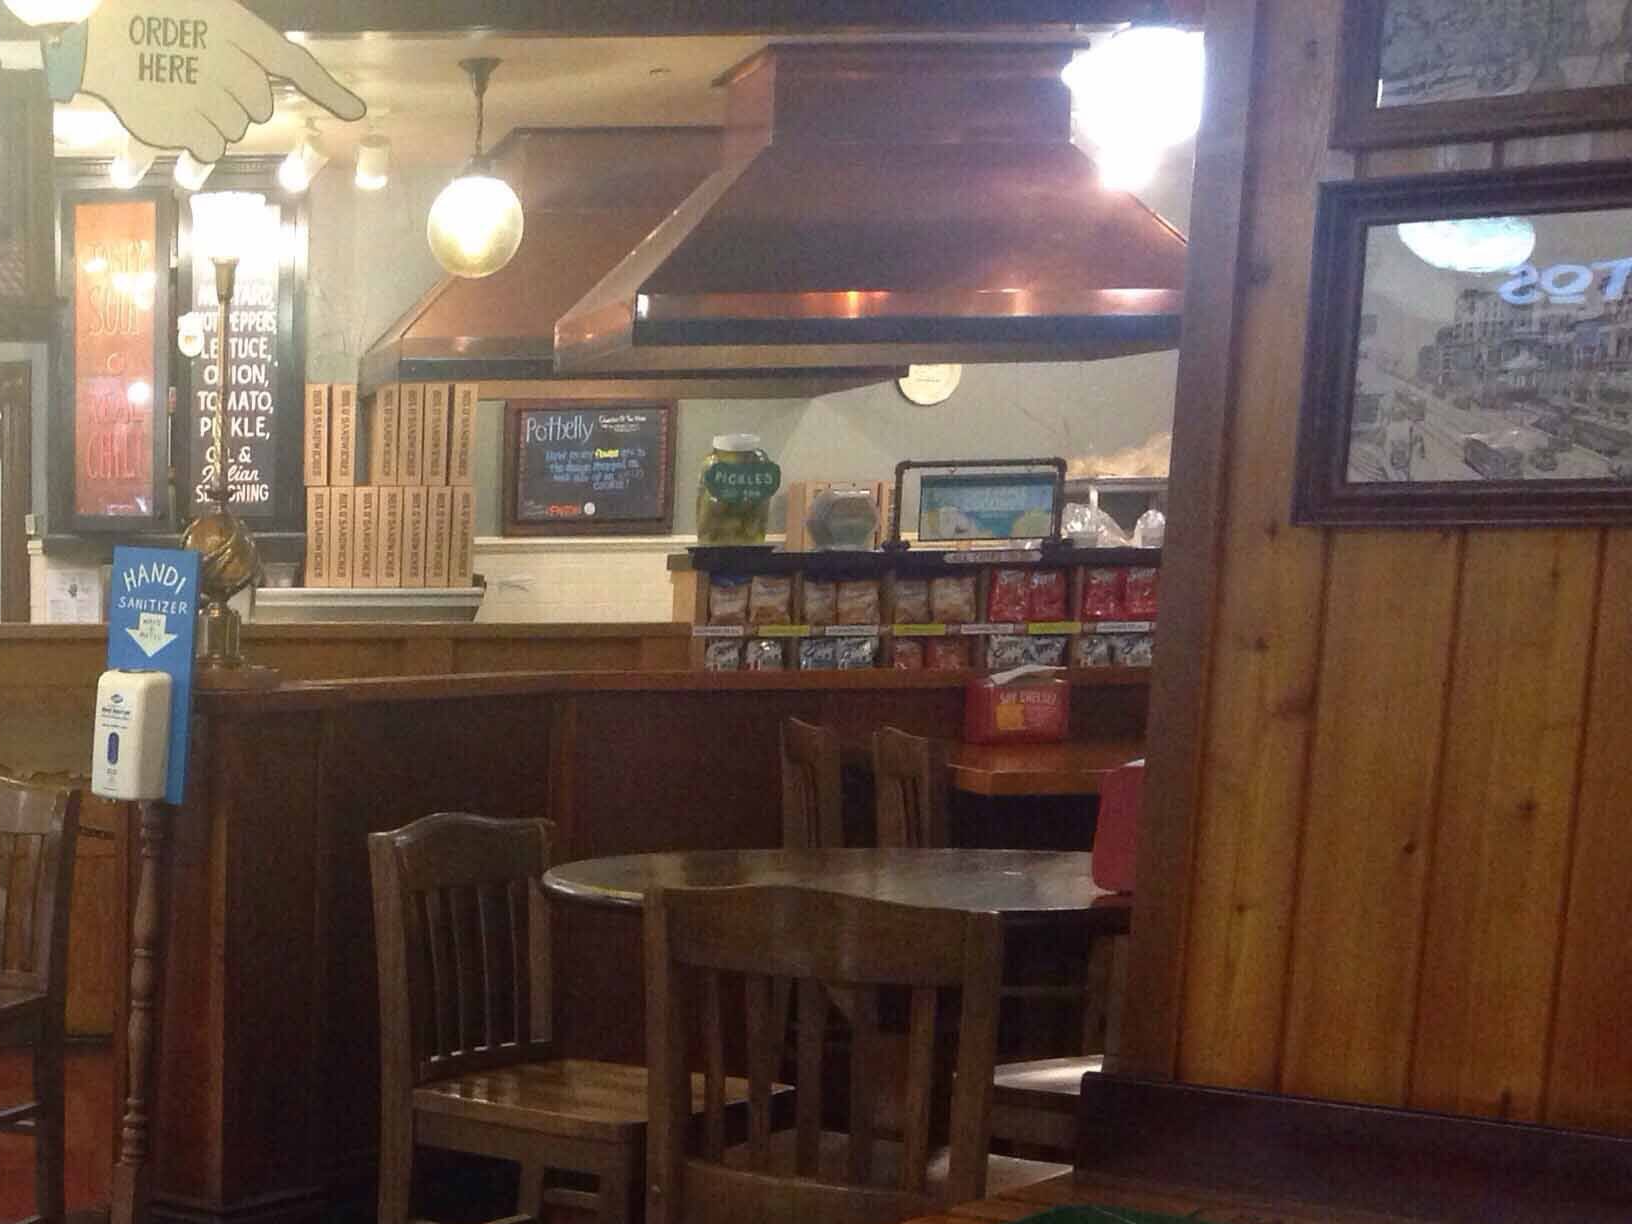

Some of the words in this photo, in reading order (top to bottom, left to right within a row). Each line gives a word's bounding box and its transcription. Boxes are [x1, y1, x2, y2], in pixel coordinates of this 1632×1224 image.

[129, 15, 208, 49] ORDER
[138, 52, 199, 85] HERE
[526, 415, 594, 443] Potbelly
[715, 470, 774, 487] PICKLES
[118, 596, 188, 615] SANITIZER
